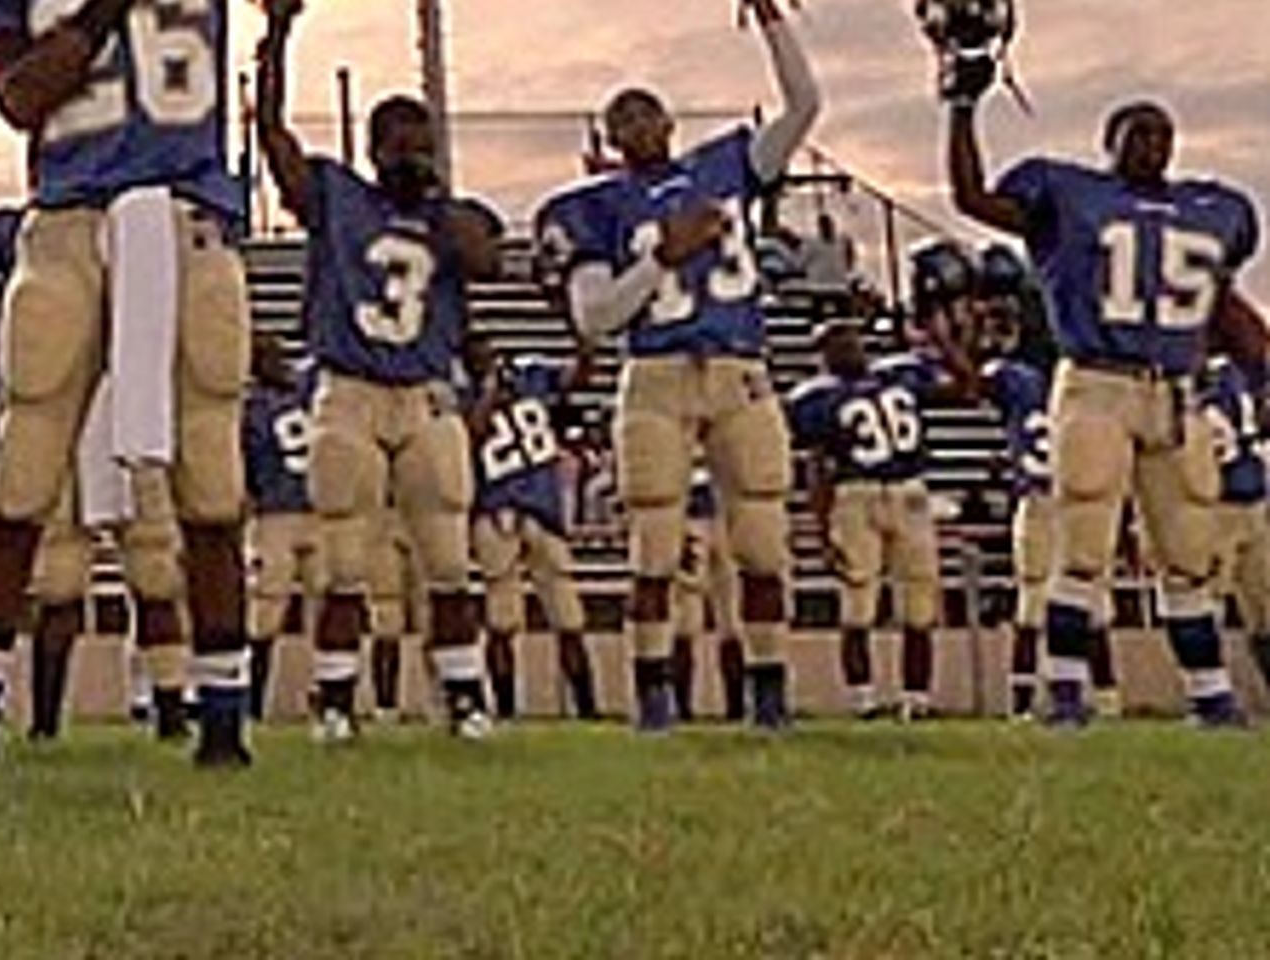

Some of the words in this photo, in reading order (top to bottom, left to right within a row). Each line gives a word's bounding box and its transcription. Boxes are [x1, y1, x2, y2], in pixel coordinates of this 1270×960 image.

[358, 236, 436, 345] 3
[1098, 221, 1226, 330] 15
[480, 398, 557, 481] 28
[839, 386, 920, 466] 36
